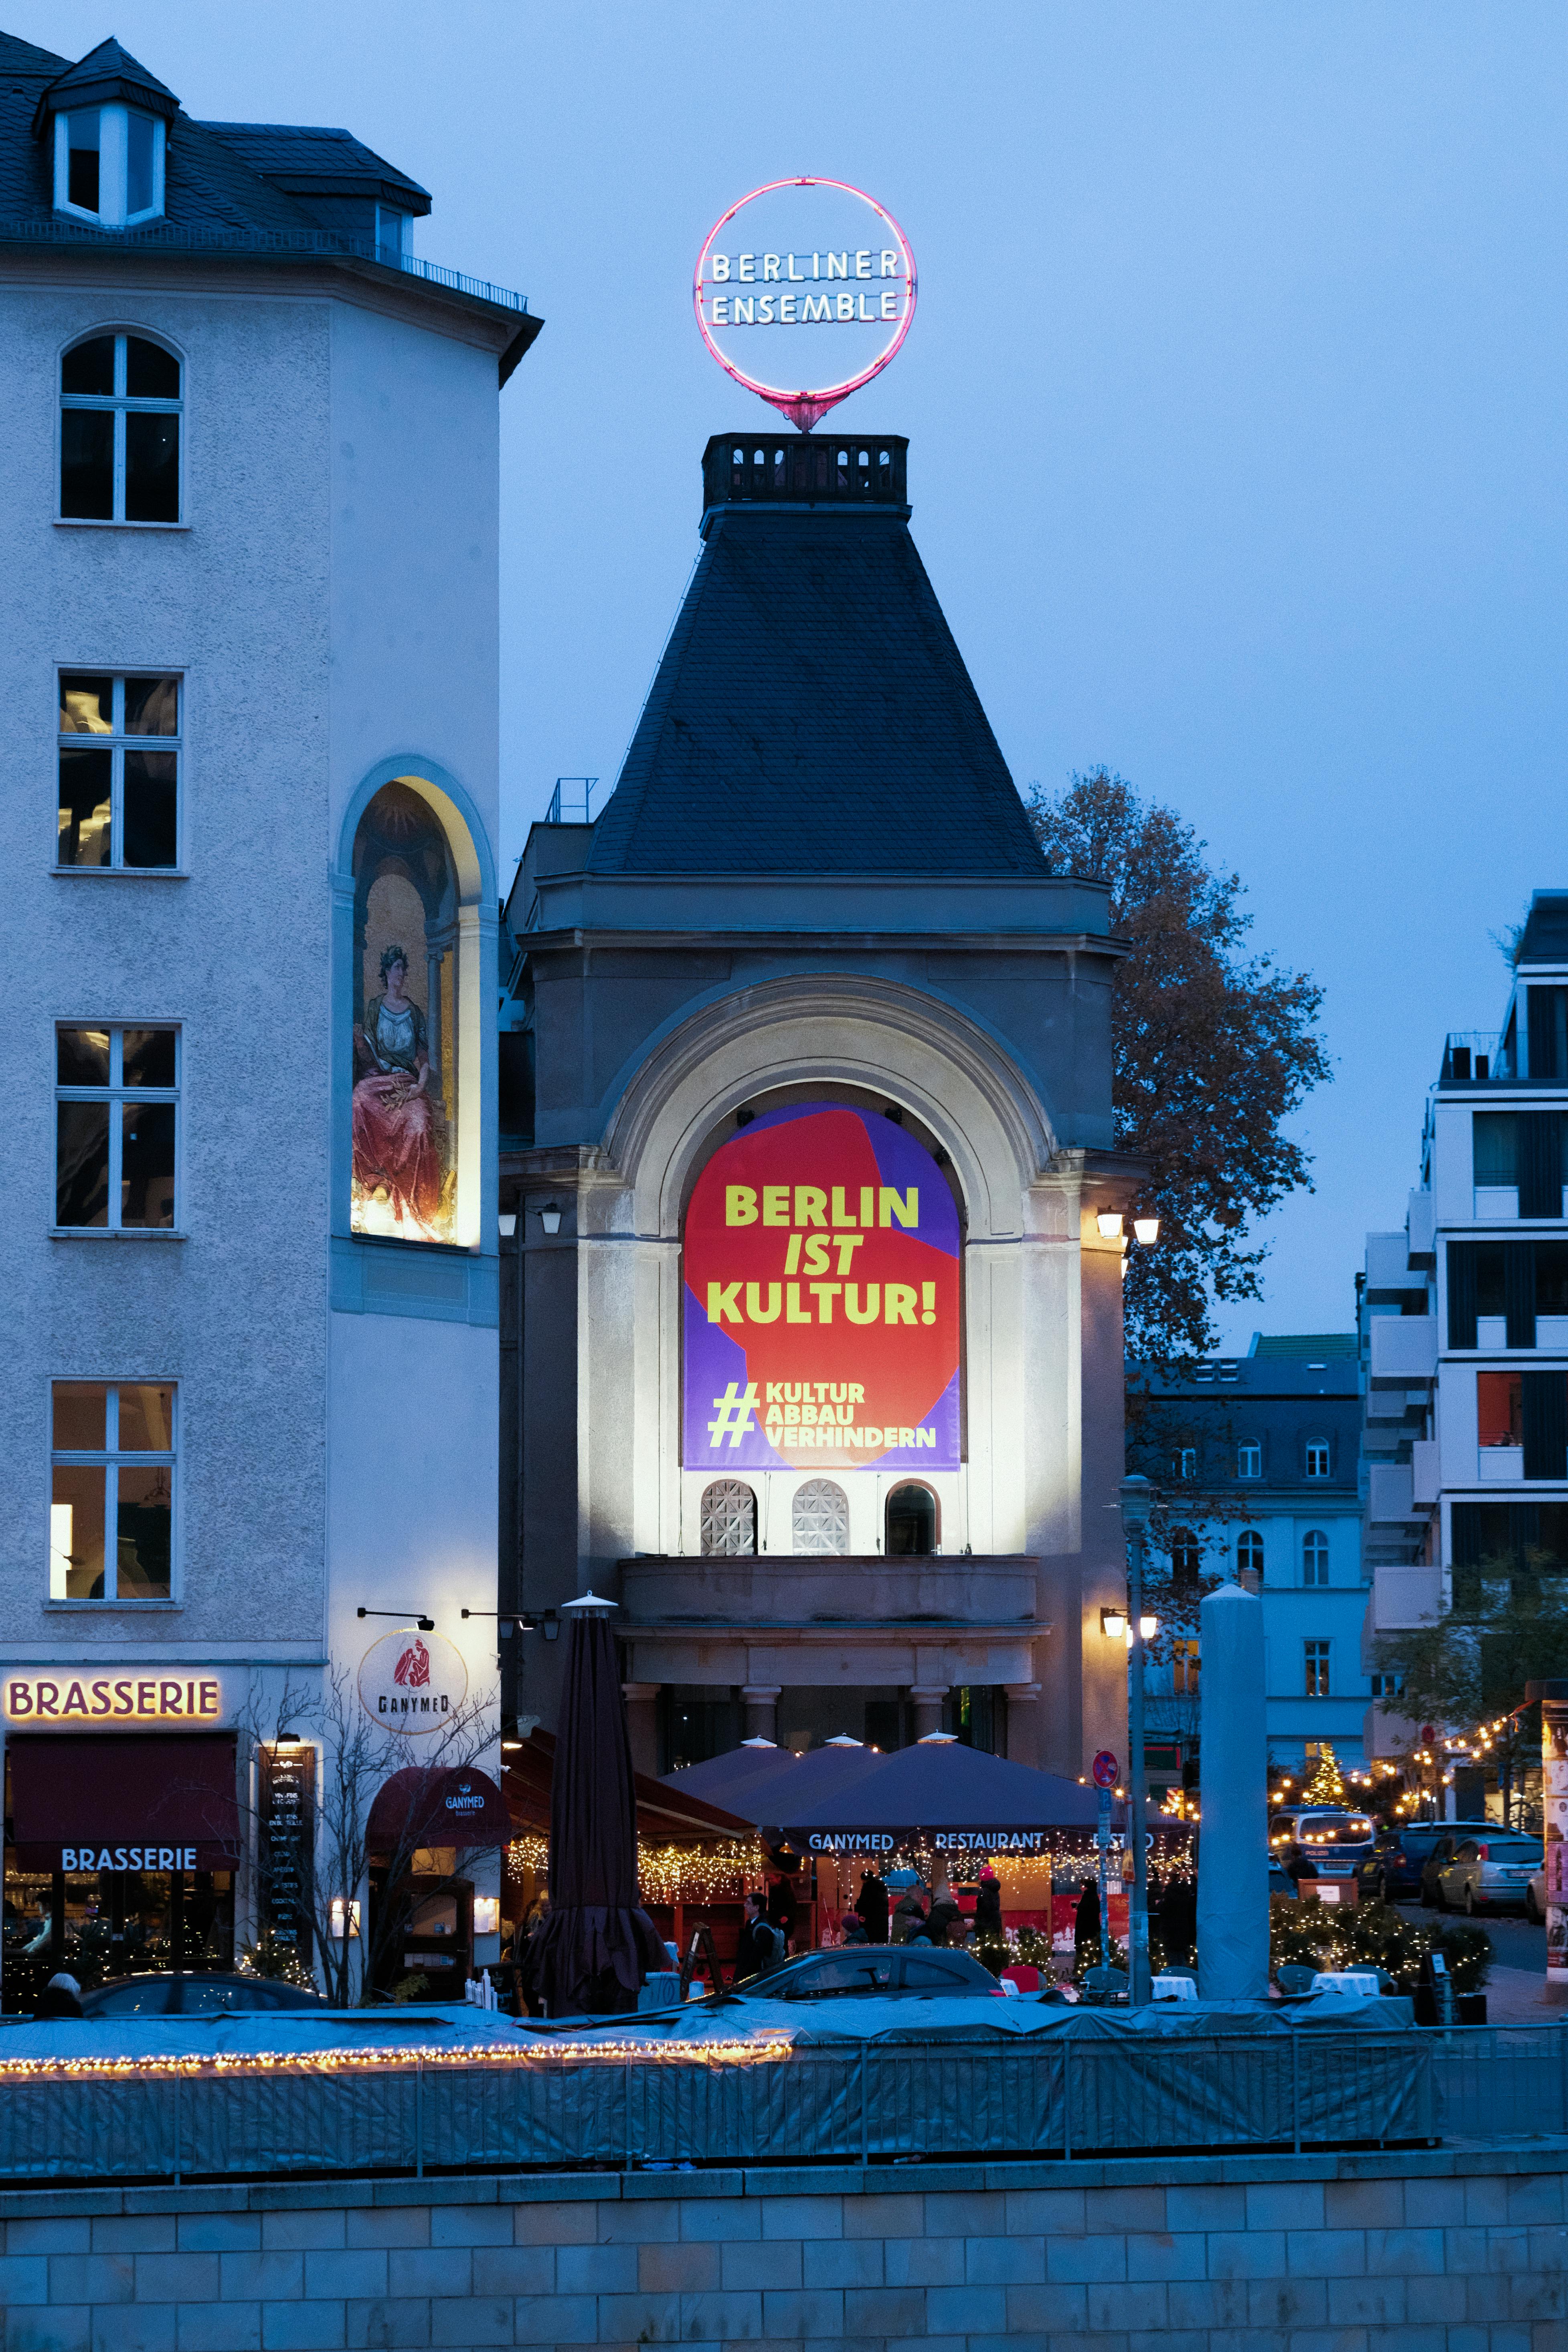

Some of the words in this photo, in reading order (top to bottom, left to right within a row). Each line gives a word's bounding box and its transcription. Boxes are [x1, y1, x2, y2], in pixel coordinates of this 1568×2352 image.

[712, 249, 898, 283] BERLINER
[712, 291, 898, 325] ENSEMBLE
[725, 1185, 919, 1228] BERLIN
[784, 1234, 864, 1275] IST
[706, 1282, 937, 1325] KULTUR!
[766, 1382, 864, 1404] KULTUR
[765, 1405, 854, 1426] ABBAU
[766, 1427, 936, 1448] VERHINDERN
[10, 1681, 218, 1715] BRASSERIE
[378, 1695, 448, 1713] GANYMED
[445, 1796, 484, 1809] GANYMED
[809, 1833, 893, 1850] GANYMED
[935, 1832, 1043, 1849] RESTAURANT
[62, 1848, 196, 1871] BRASSERIE
